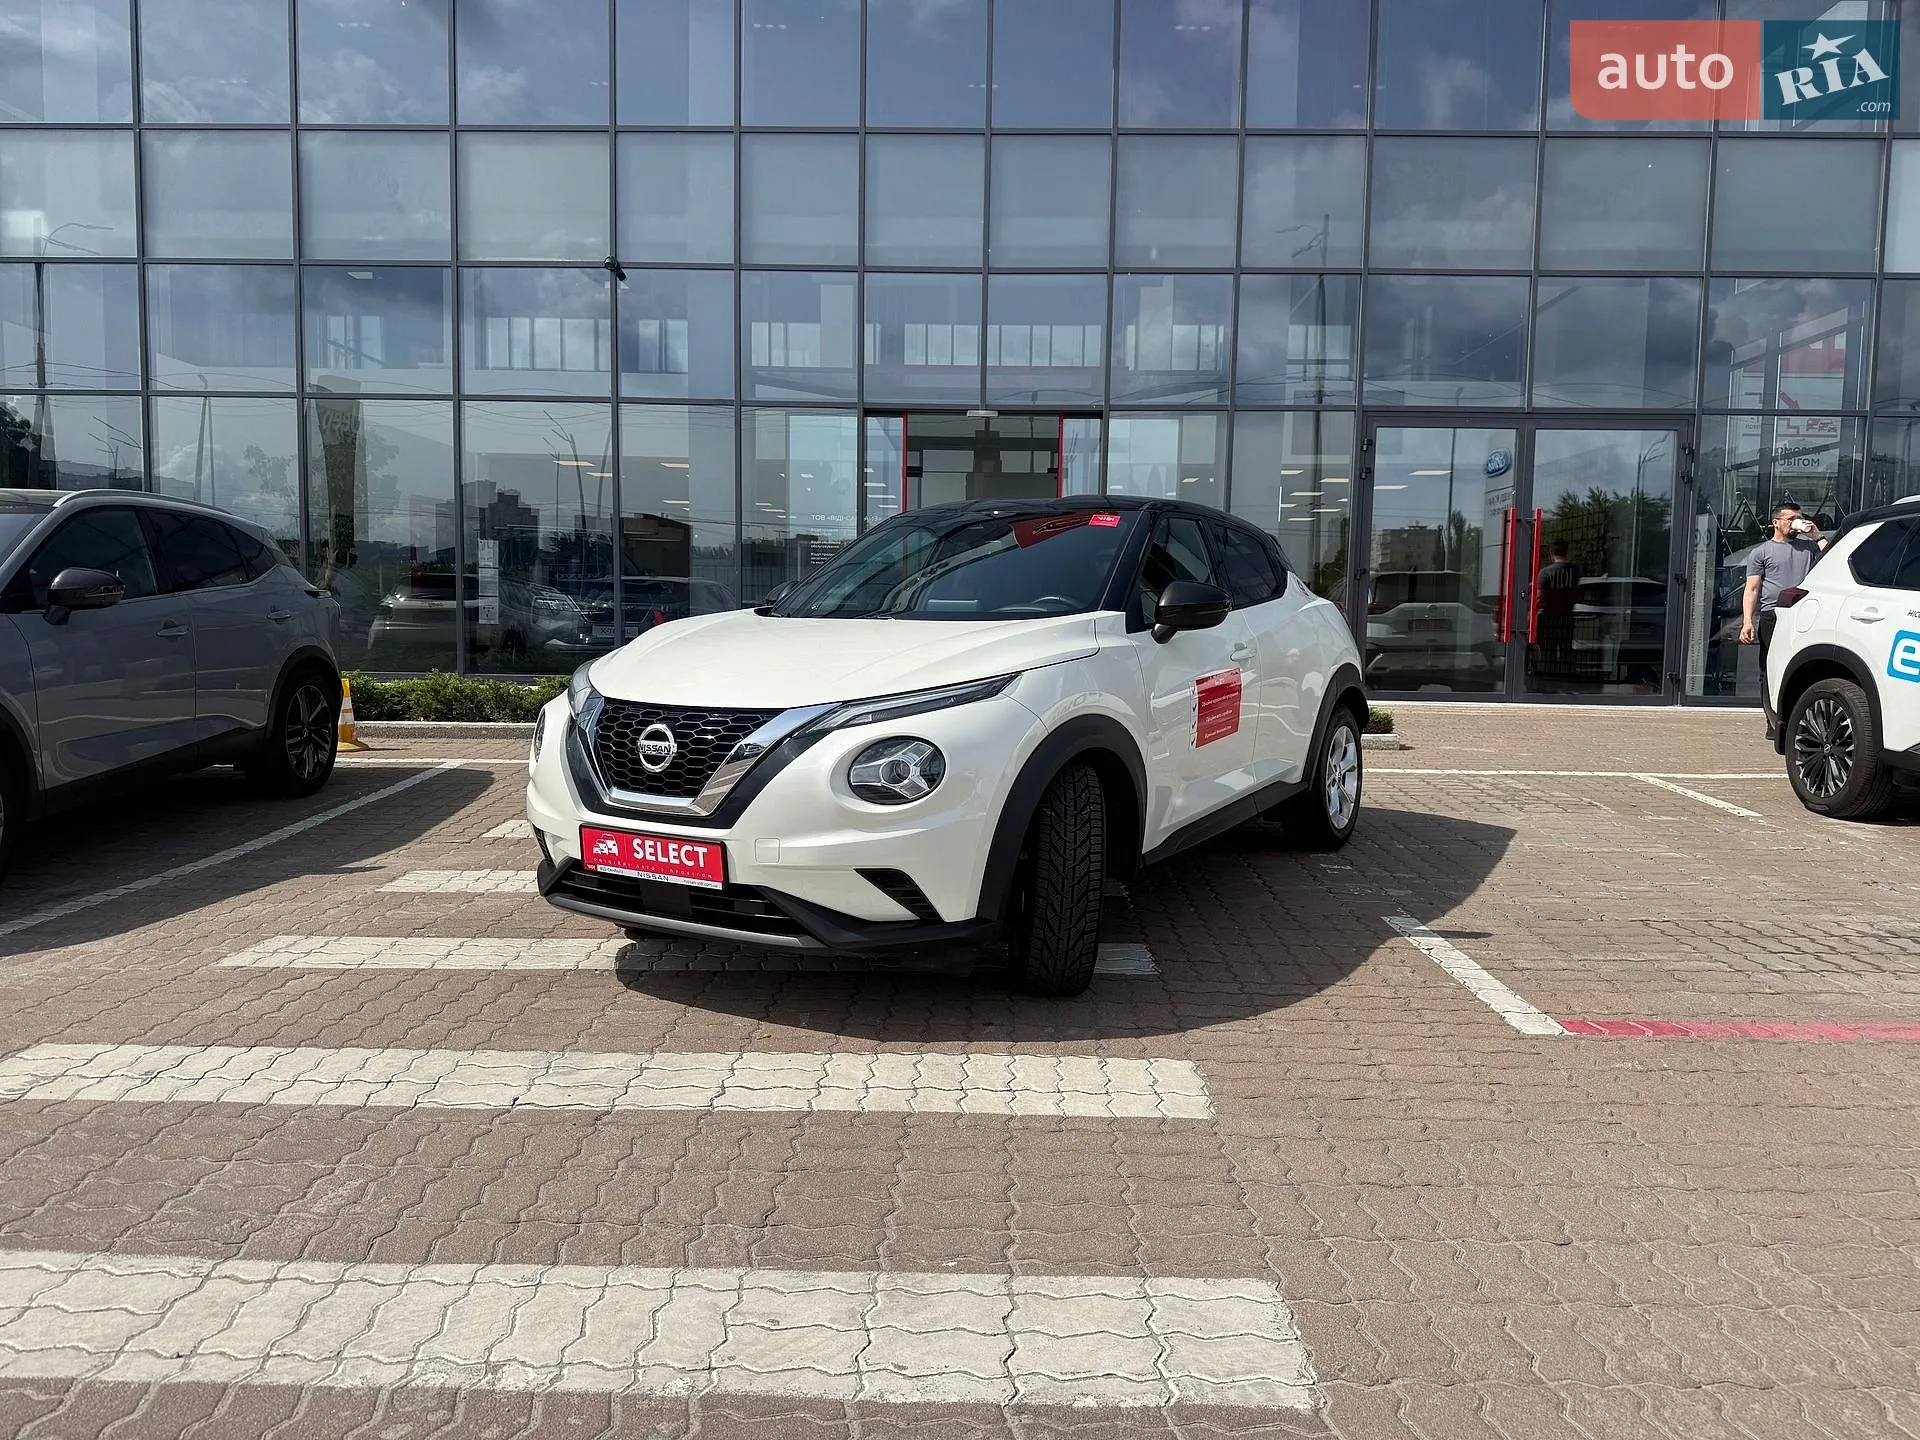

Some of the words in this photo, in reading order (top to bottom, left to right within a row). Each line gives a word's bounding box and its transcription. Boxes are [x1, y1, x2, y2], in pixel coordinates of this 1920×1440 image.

[640, 743, 671, 754] NISSAN
[632, 838, 708, 868] SELECT
[637, 871, 669, 881] NISSAN
[669, 869, 713, 880] ПРОБІГОМ
